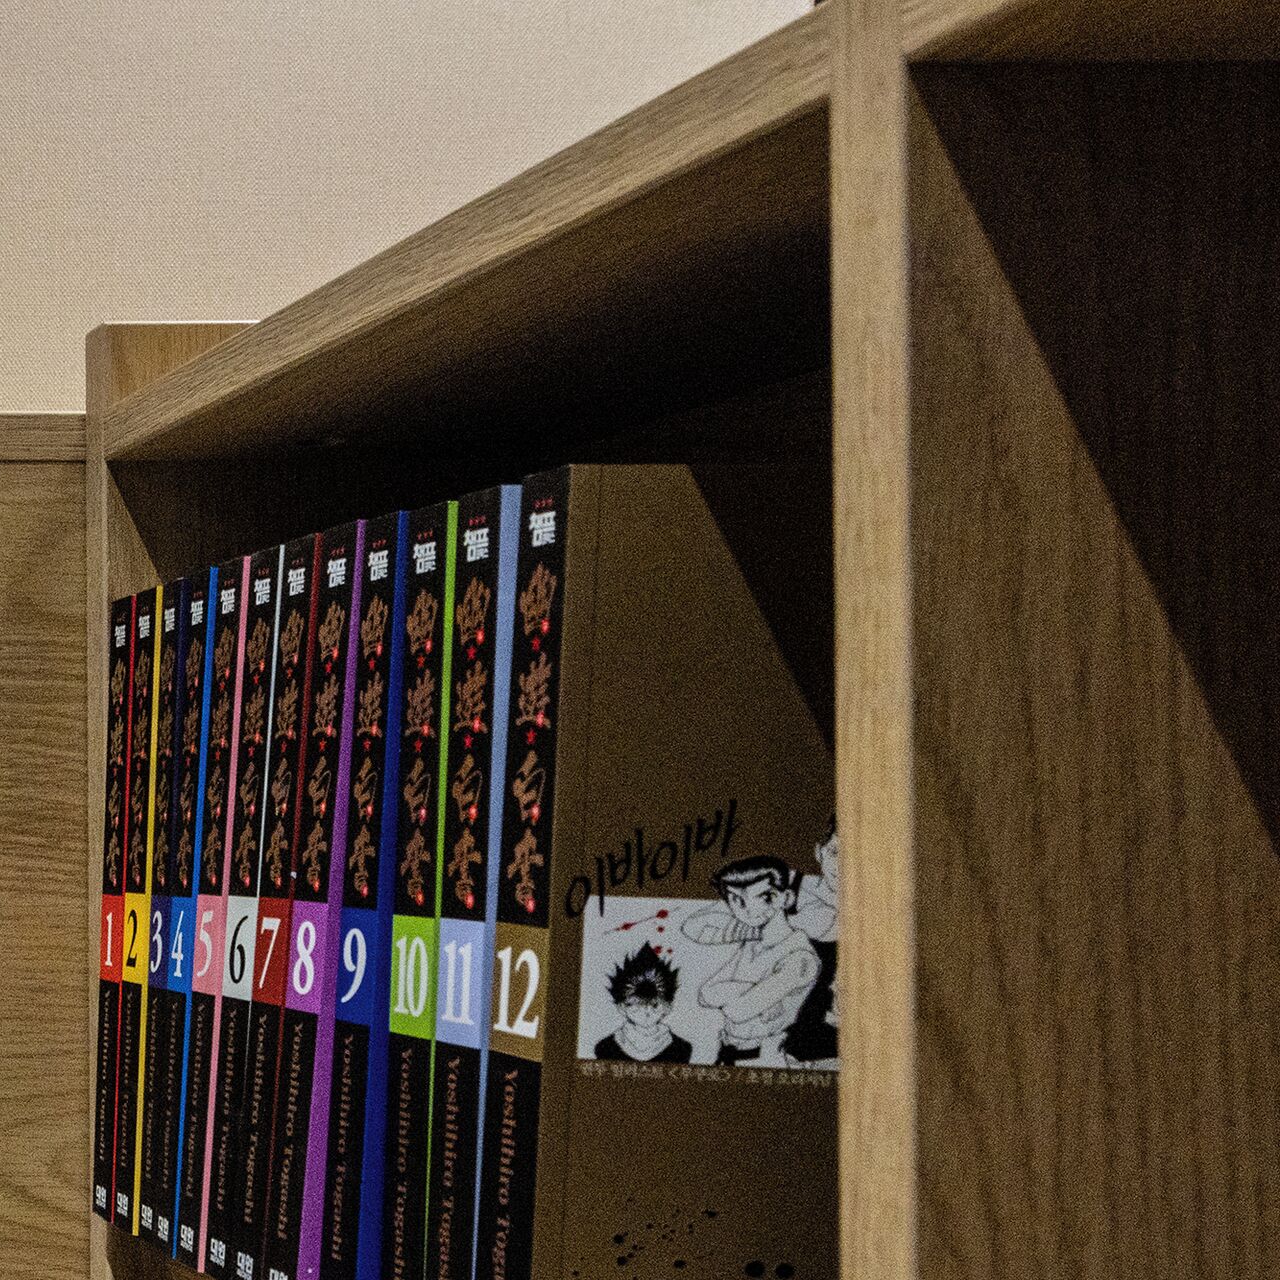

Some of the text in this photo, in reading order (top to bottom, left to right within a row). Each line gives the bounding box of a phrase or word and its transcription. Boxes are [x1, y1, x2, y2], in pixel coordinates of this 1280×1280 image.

[104, 912, 113, 967] 1
[126, 909, 138, 968] 2
[150, 911, 163, 973] 3
[171, 911, 184, 977] 4
[197, 910, 213, 977] 5
[229, 916, 249, 983] 6
[259, 917, 281, 989] 7
[293, 921, 316, 995] 8
[341, 928, 367, 1003] 9
[393, 935, 428, 1017] 10
[441, 940, 474, 1025] 11
[493, 946, 540, 1038] 12
